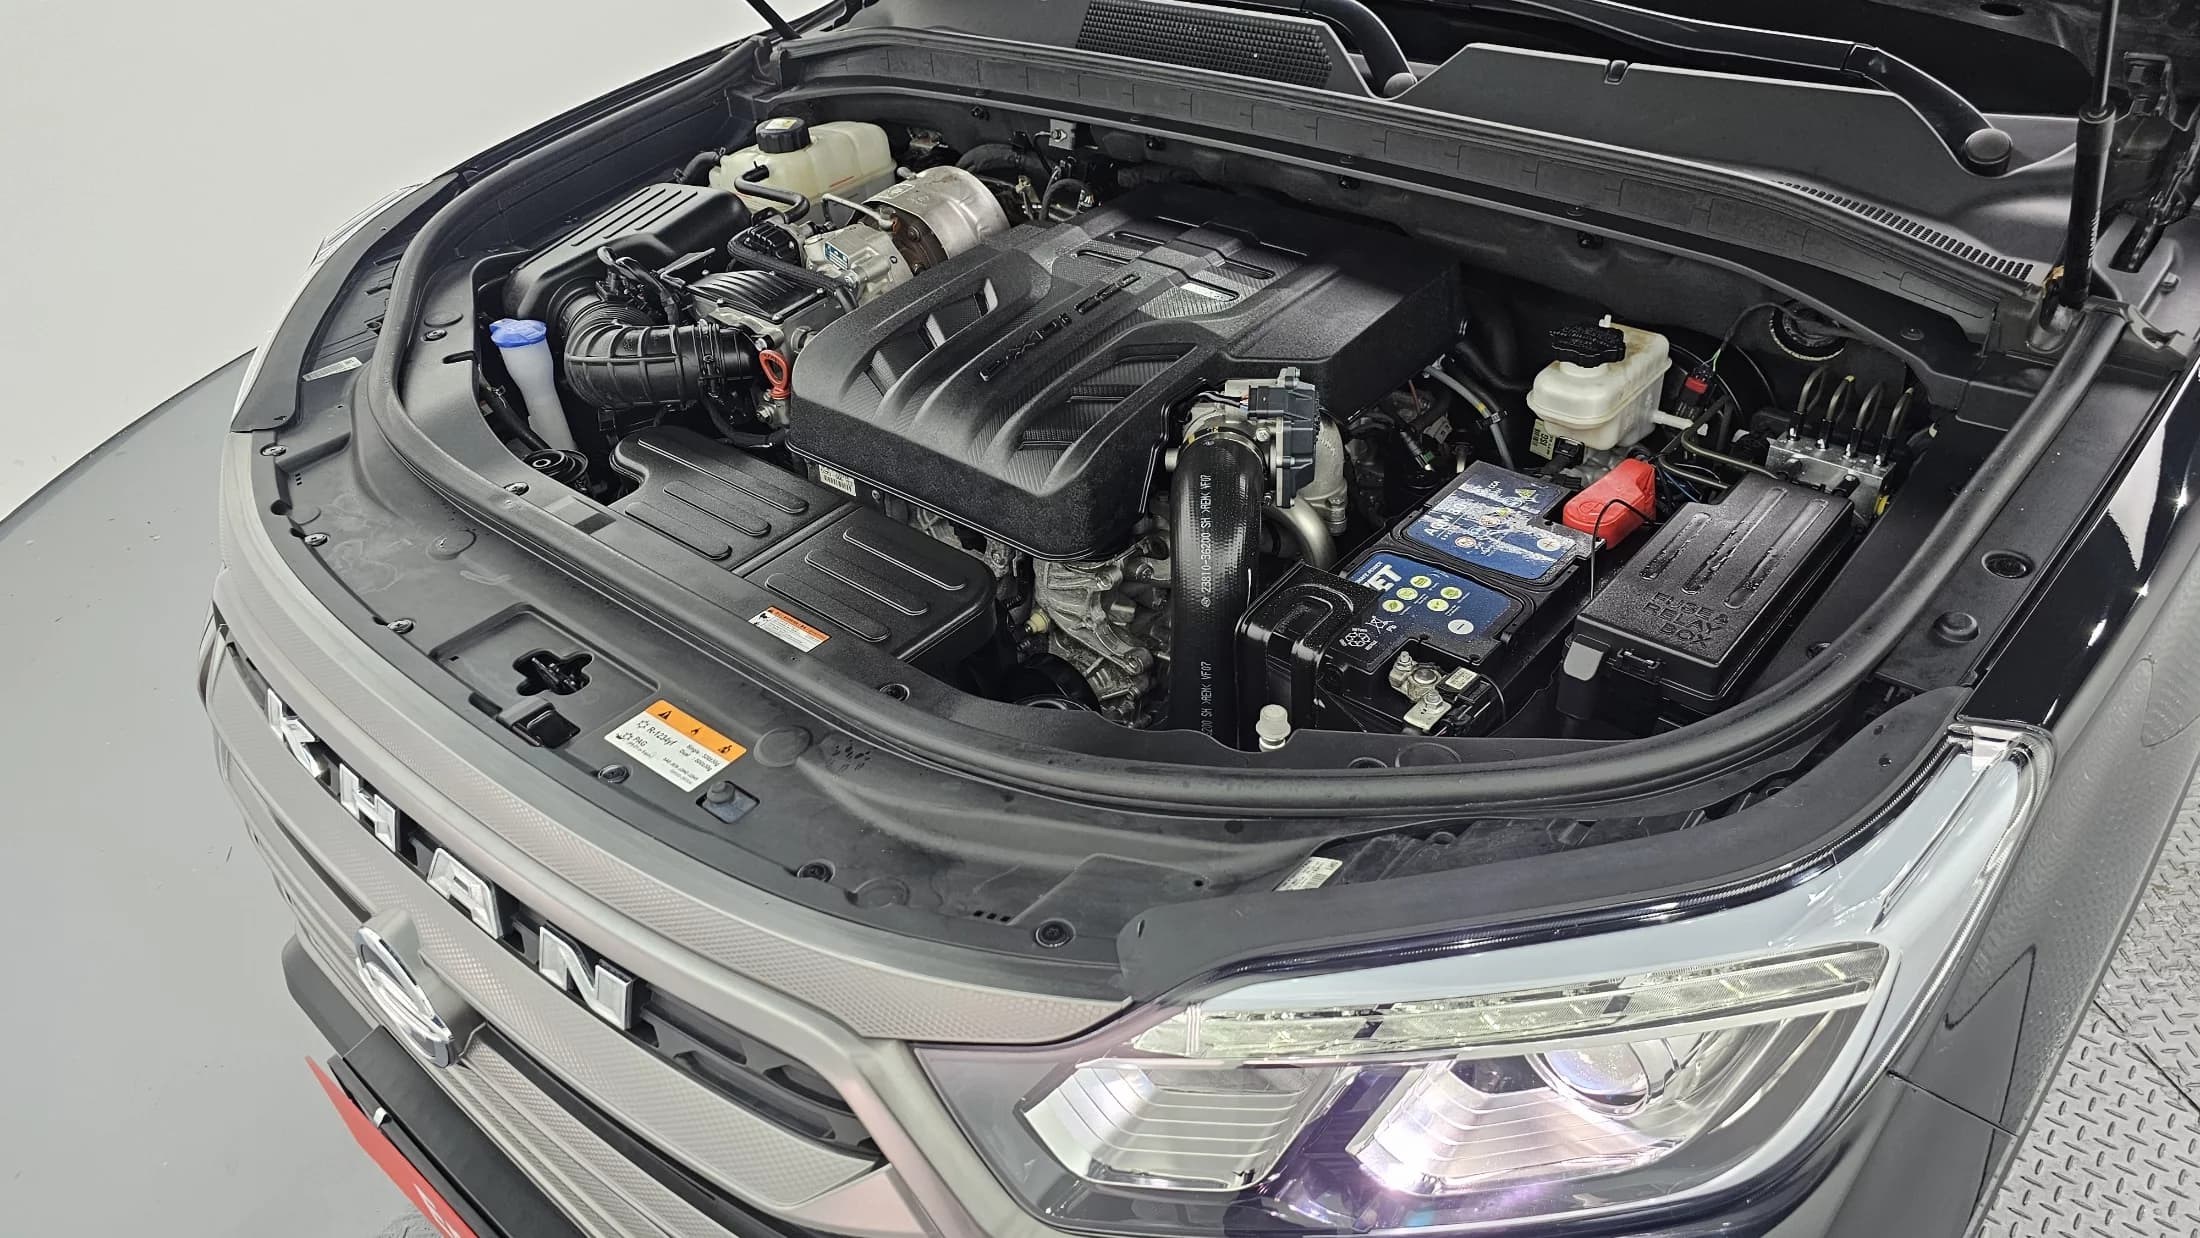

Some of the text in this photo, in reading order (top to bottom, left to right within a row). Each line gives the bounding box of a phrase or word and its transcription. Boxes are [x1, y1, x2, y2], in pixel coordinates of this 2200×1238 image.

[1200, 517, 1211, 529] SH
[1200, 532, 1211, 593] 23810-36200
[1641, 602, 1724, 635] RELAY
[1660, 622, 1713, 649] BOX
[632, 736, 648, 747] PAG
[267, 688, 632, 1030] KHAN
